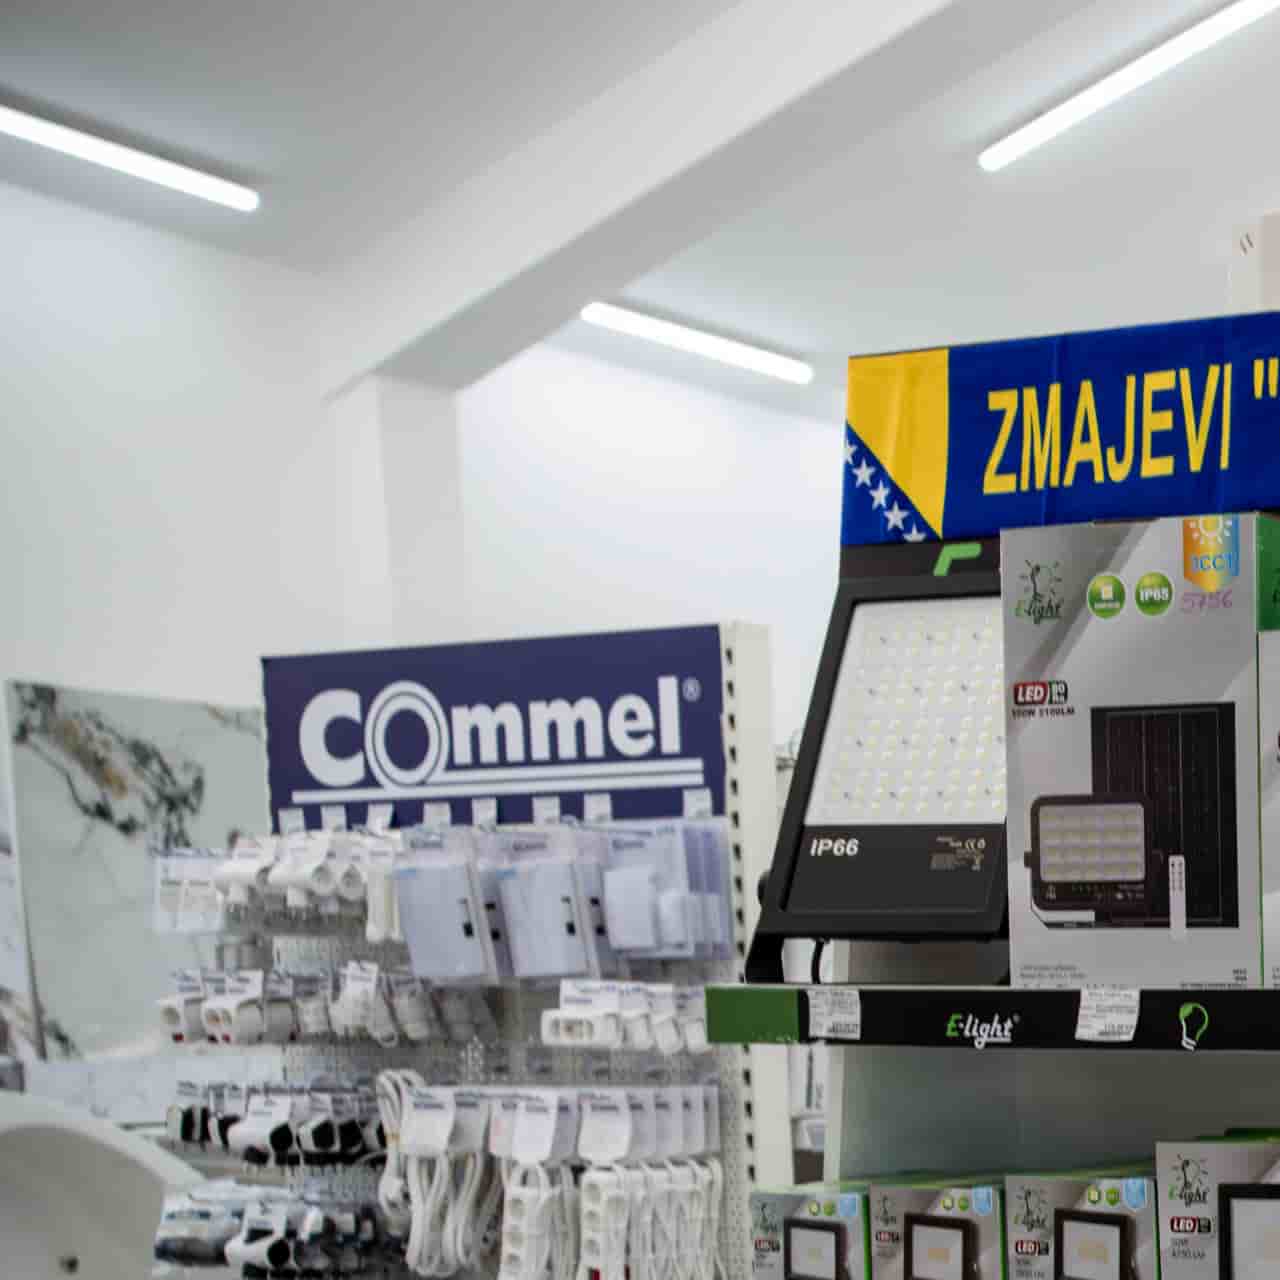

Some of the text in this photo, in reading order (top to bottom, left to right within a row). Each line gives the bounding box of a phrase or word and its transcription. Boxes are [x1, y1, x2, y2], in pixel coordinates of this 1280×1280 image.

[982, 363, 1233, 495] ZMAJEVI
[1017, 684, 1044, 703] LED
[810, 838, 859, 857] IP66
[946, 1013, 1013, 1050] E-light
